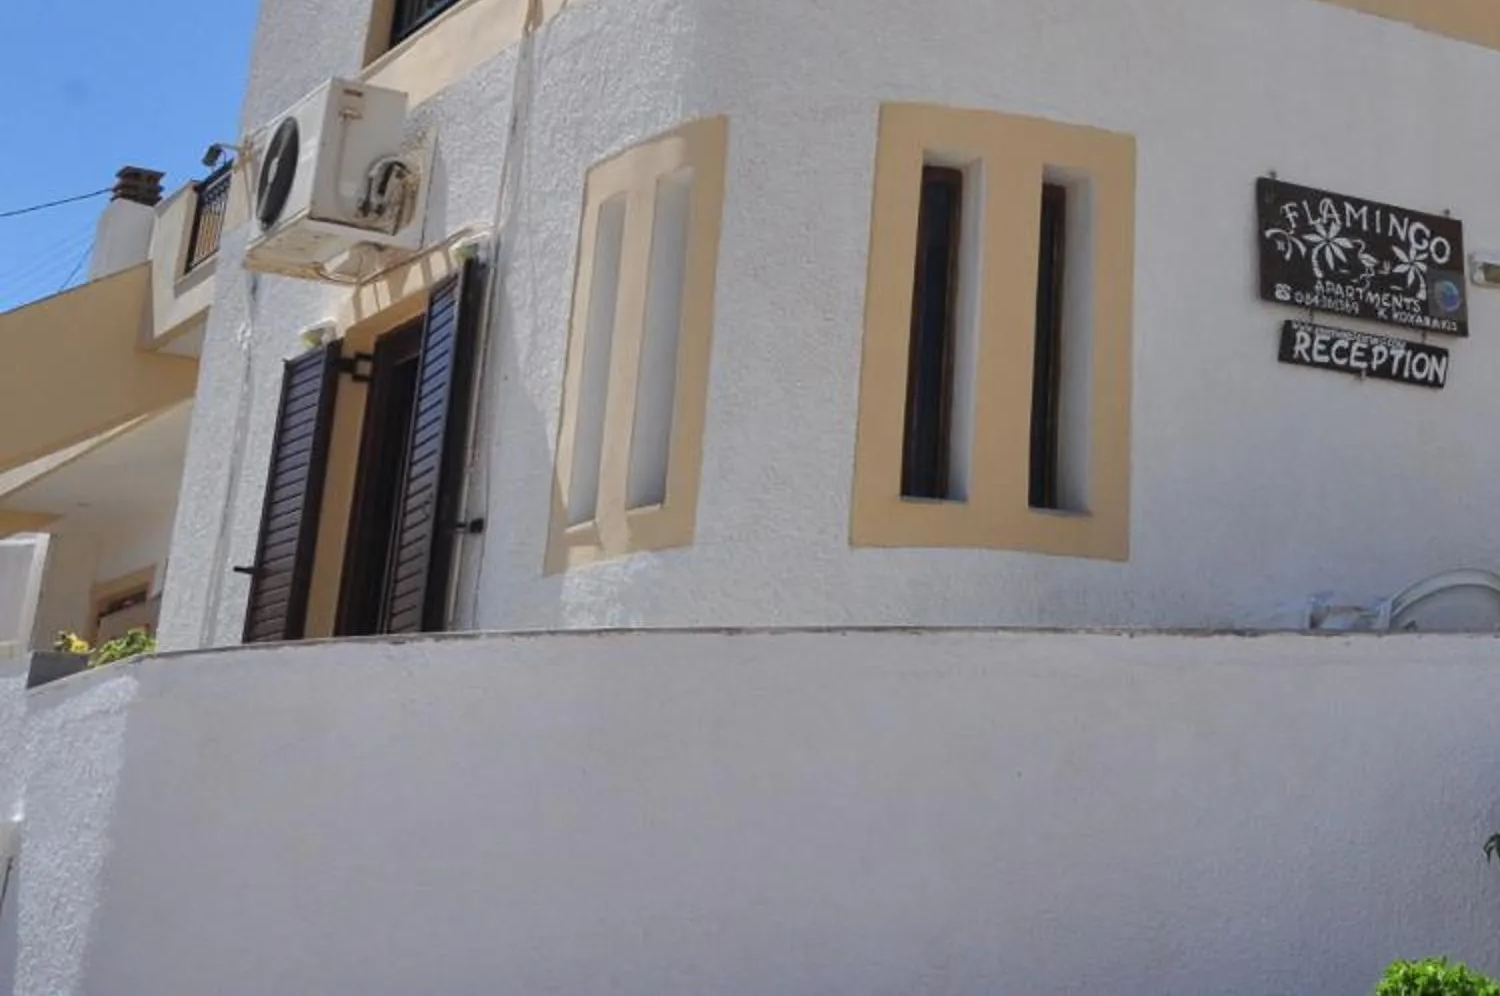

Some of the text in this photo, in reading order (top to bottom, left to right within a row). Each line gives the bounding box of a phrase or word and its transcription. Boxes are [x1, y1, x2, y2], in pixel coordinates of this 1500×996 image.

[1281, 197, 1451, 265] FLAMINGO
[1315, 279, 1422, 313] APARTMENTS
[1292, 331, 1448, 384] RECEPTION
